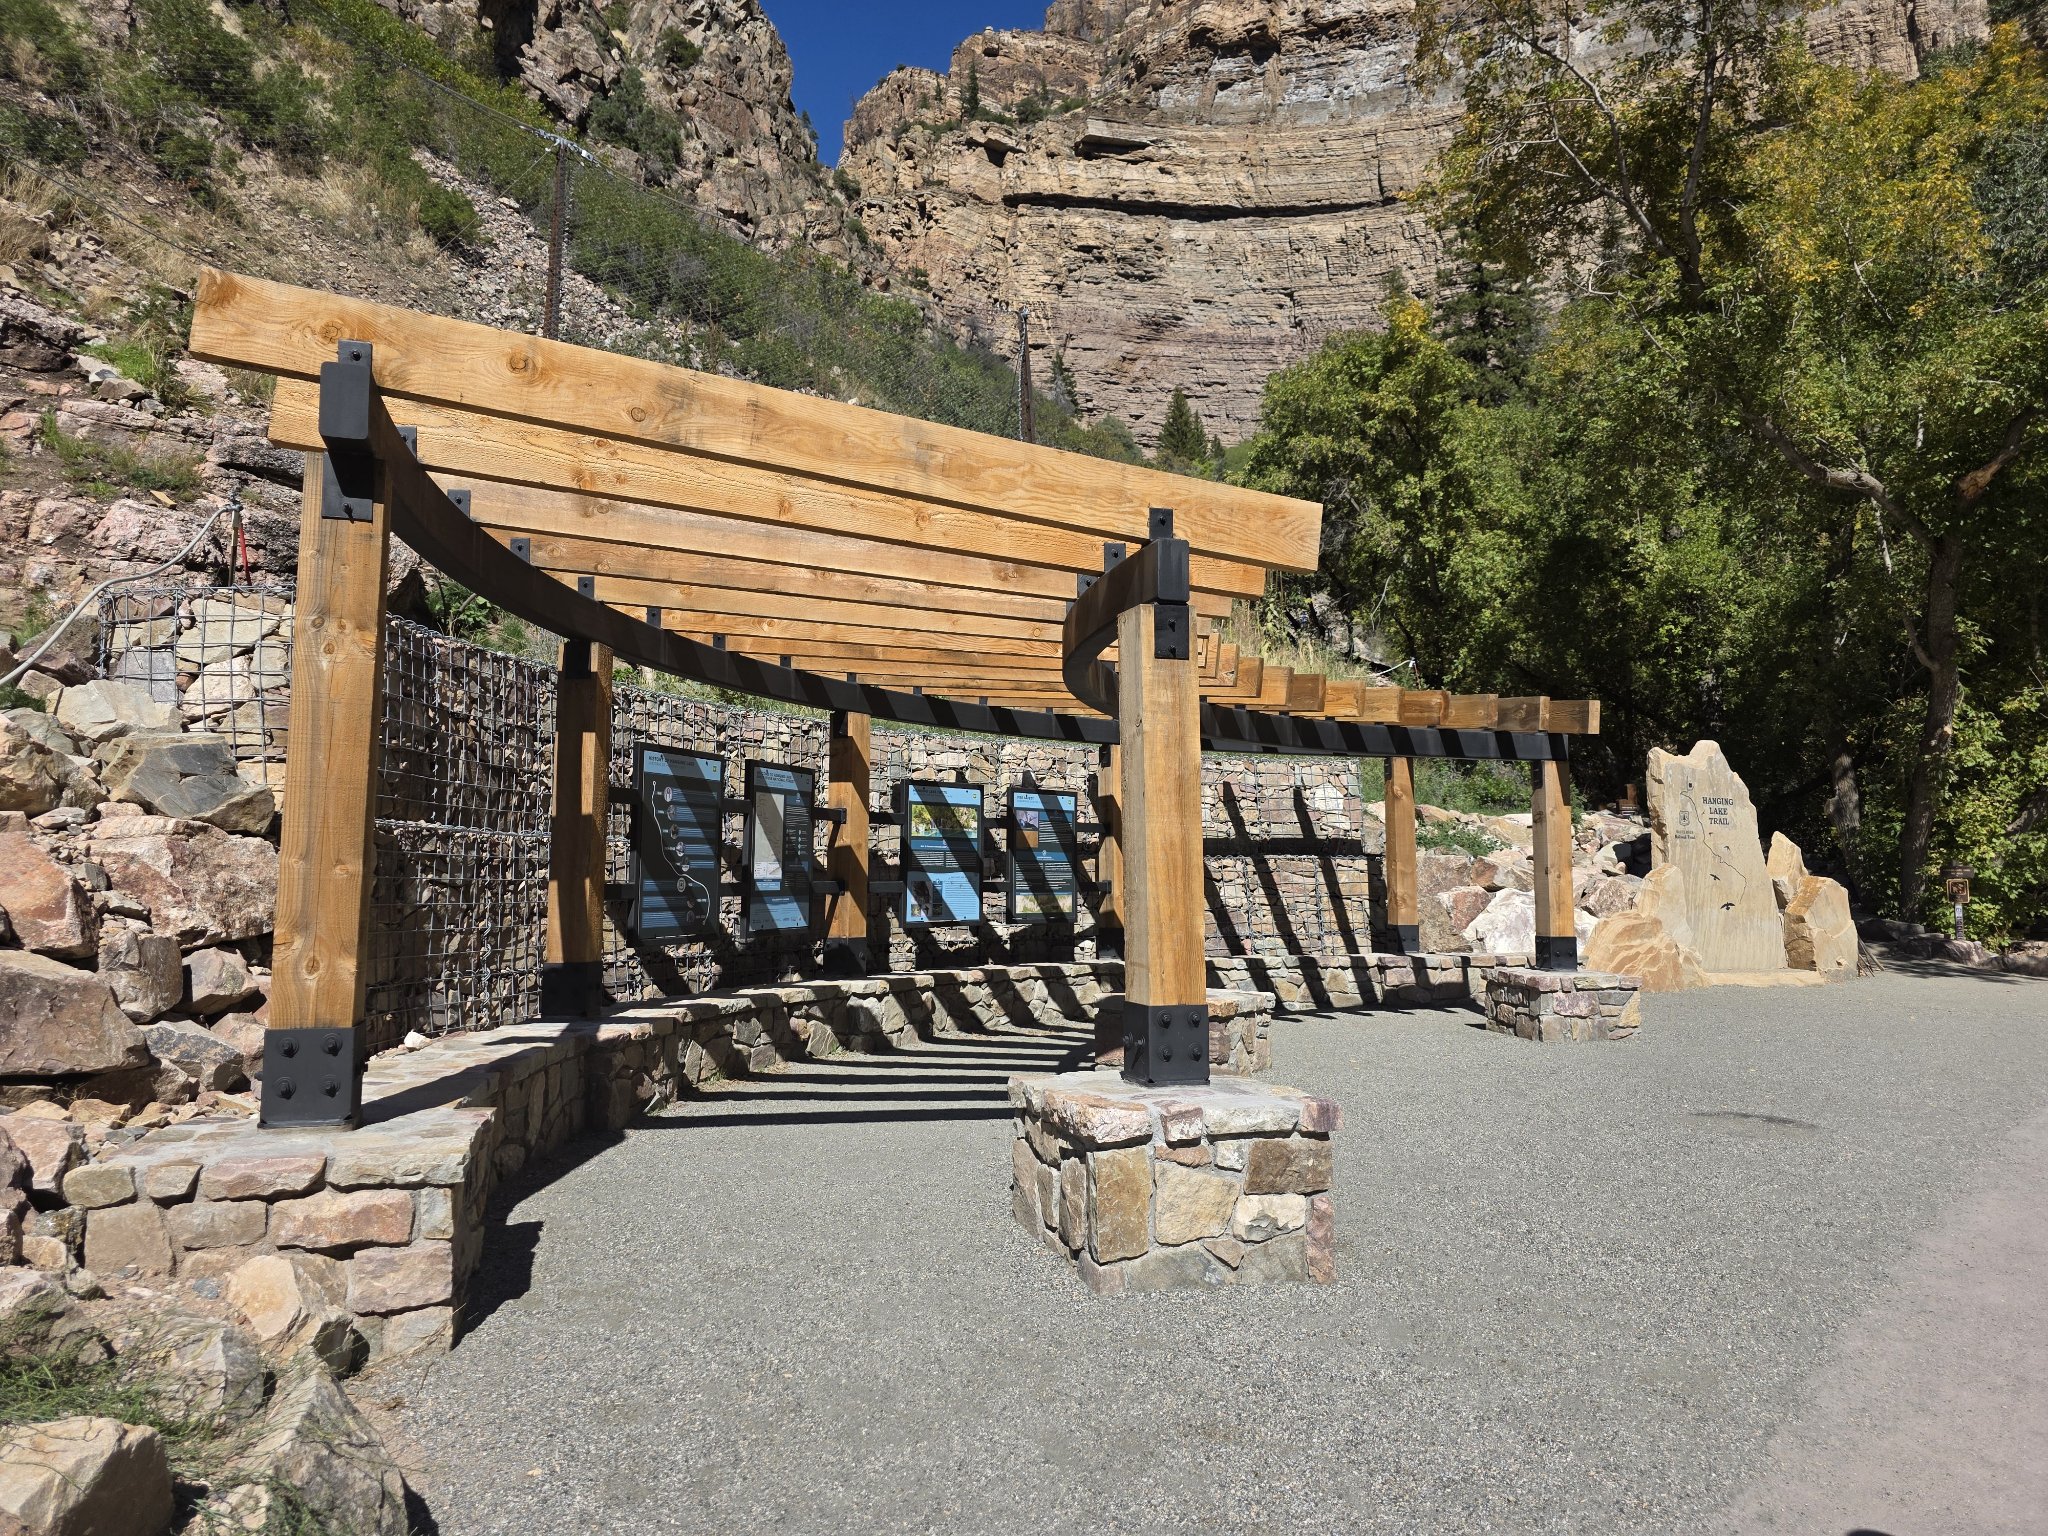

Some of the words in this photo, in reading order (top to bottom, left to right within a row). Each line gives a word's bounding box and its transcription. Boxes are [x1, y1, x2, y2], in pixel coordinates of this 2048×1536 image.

[1702, 797, 1733, 805] HANGING
[1709, 807, 1728, 815] LAKE
[1709, 817, 1729, 825] TRAIL
